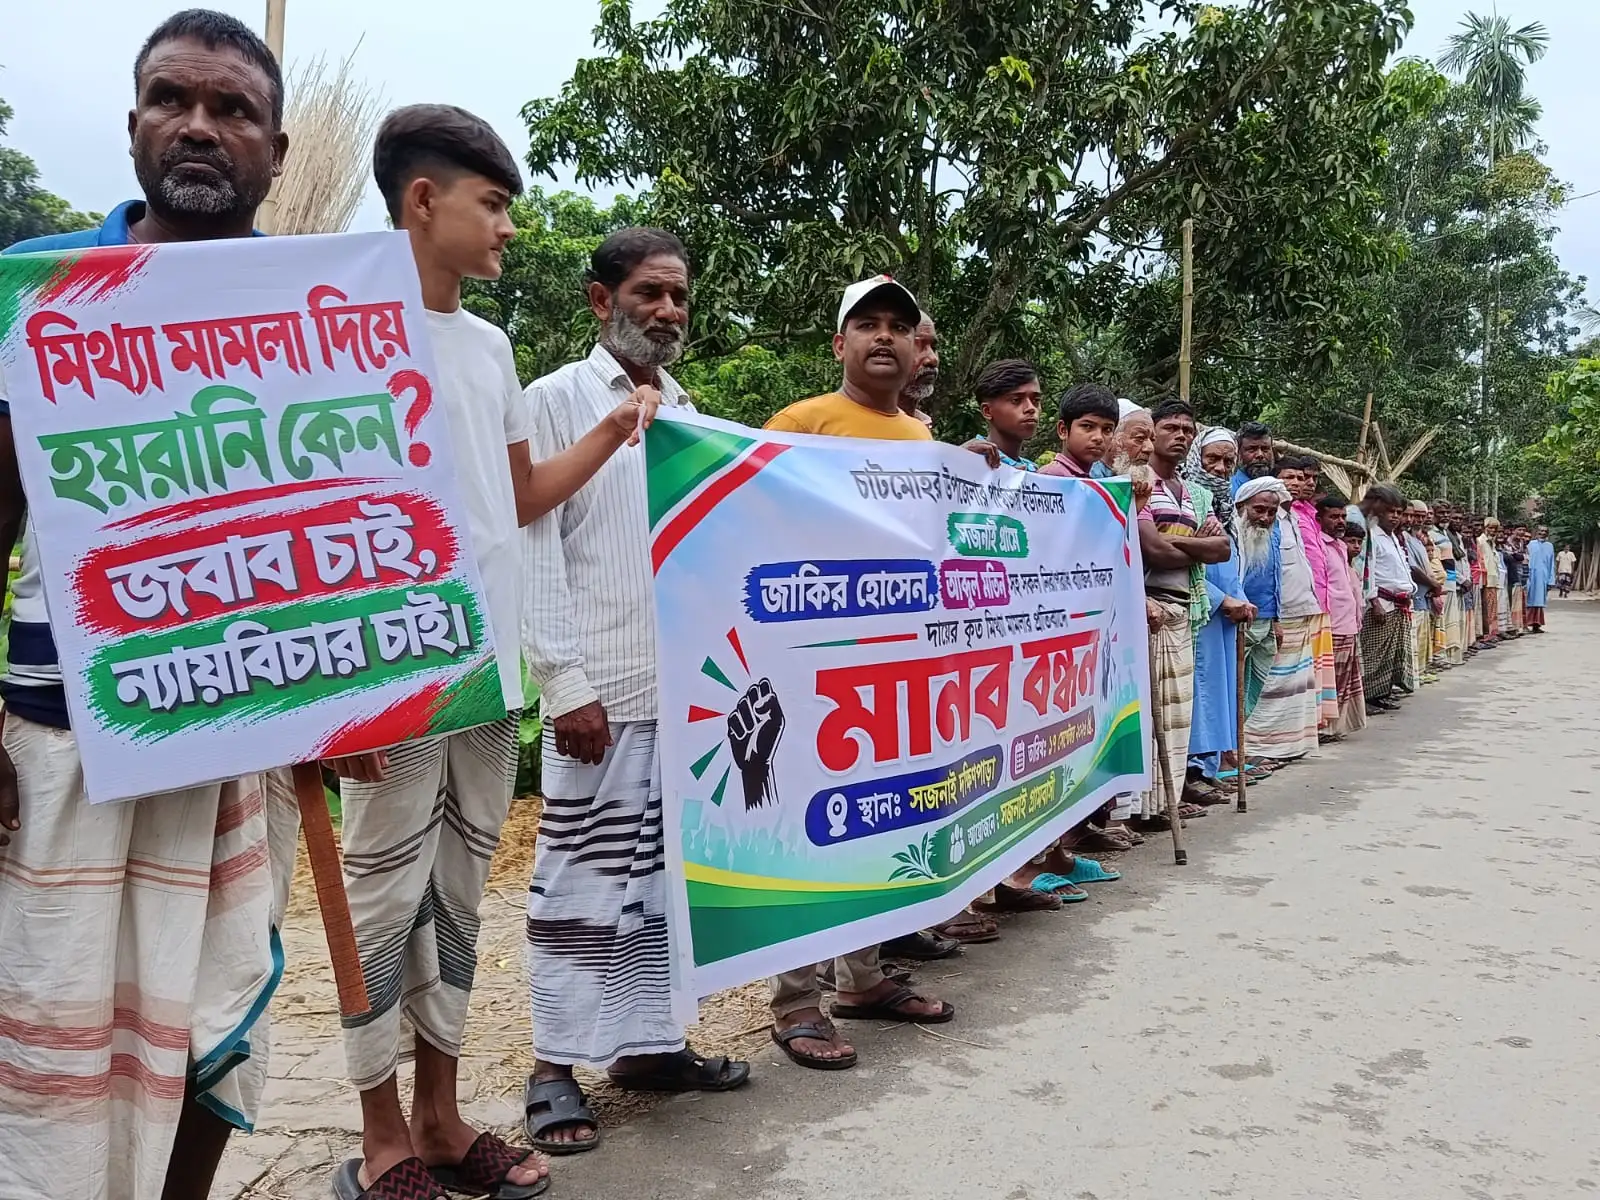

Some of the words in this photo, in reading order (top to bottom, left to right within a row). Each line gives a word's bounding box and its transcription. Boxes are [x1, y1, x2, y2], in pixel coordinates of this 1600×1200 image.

[26, 311, 165, 405] মিথ্যা
[161, 311, 312, 381] মামলা
[307, 284, 412, 373] দিয়ে
[37, 385, 275, 514] হয়রানি
[850, 459, 942, 503] চাটমোহর
[942, 463, 987, 509] উপজেলার
[106, 528, 299, 621] জবাব
[304, 499, 438, 585] চাই,
[999, 524, 1021, 553] গ্রামে
[759, 563, 849, 613] জাকির
[856, 571, 936, 610] হোসেন,
[979, 562, 1008, 600] মতিন
[112, 618, 368, 712] ন্যায়বিচার
[370, 591, 470, 657] চাই।
[925, 618, 959, 648] দায়ের
[963, 617, 984, 648] কৃত
[815, 645, 1014, 772] মানব
[1020, 629, 1100, 716] বন্ধন
[908, 769, 958, 812] সজনাই
